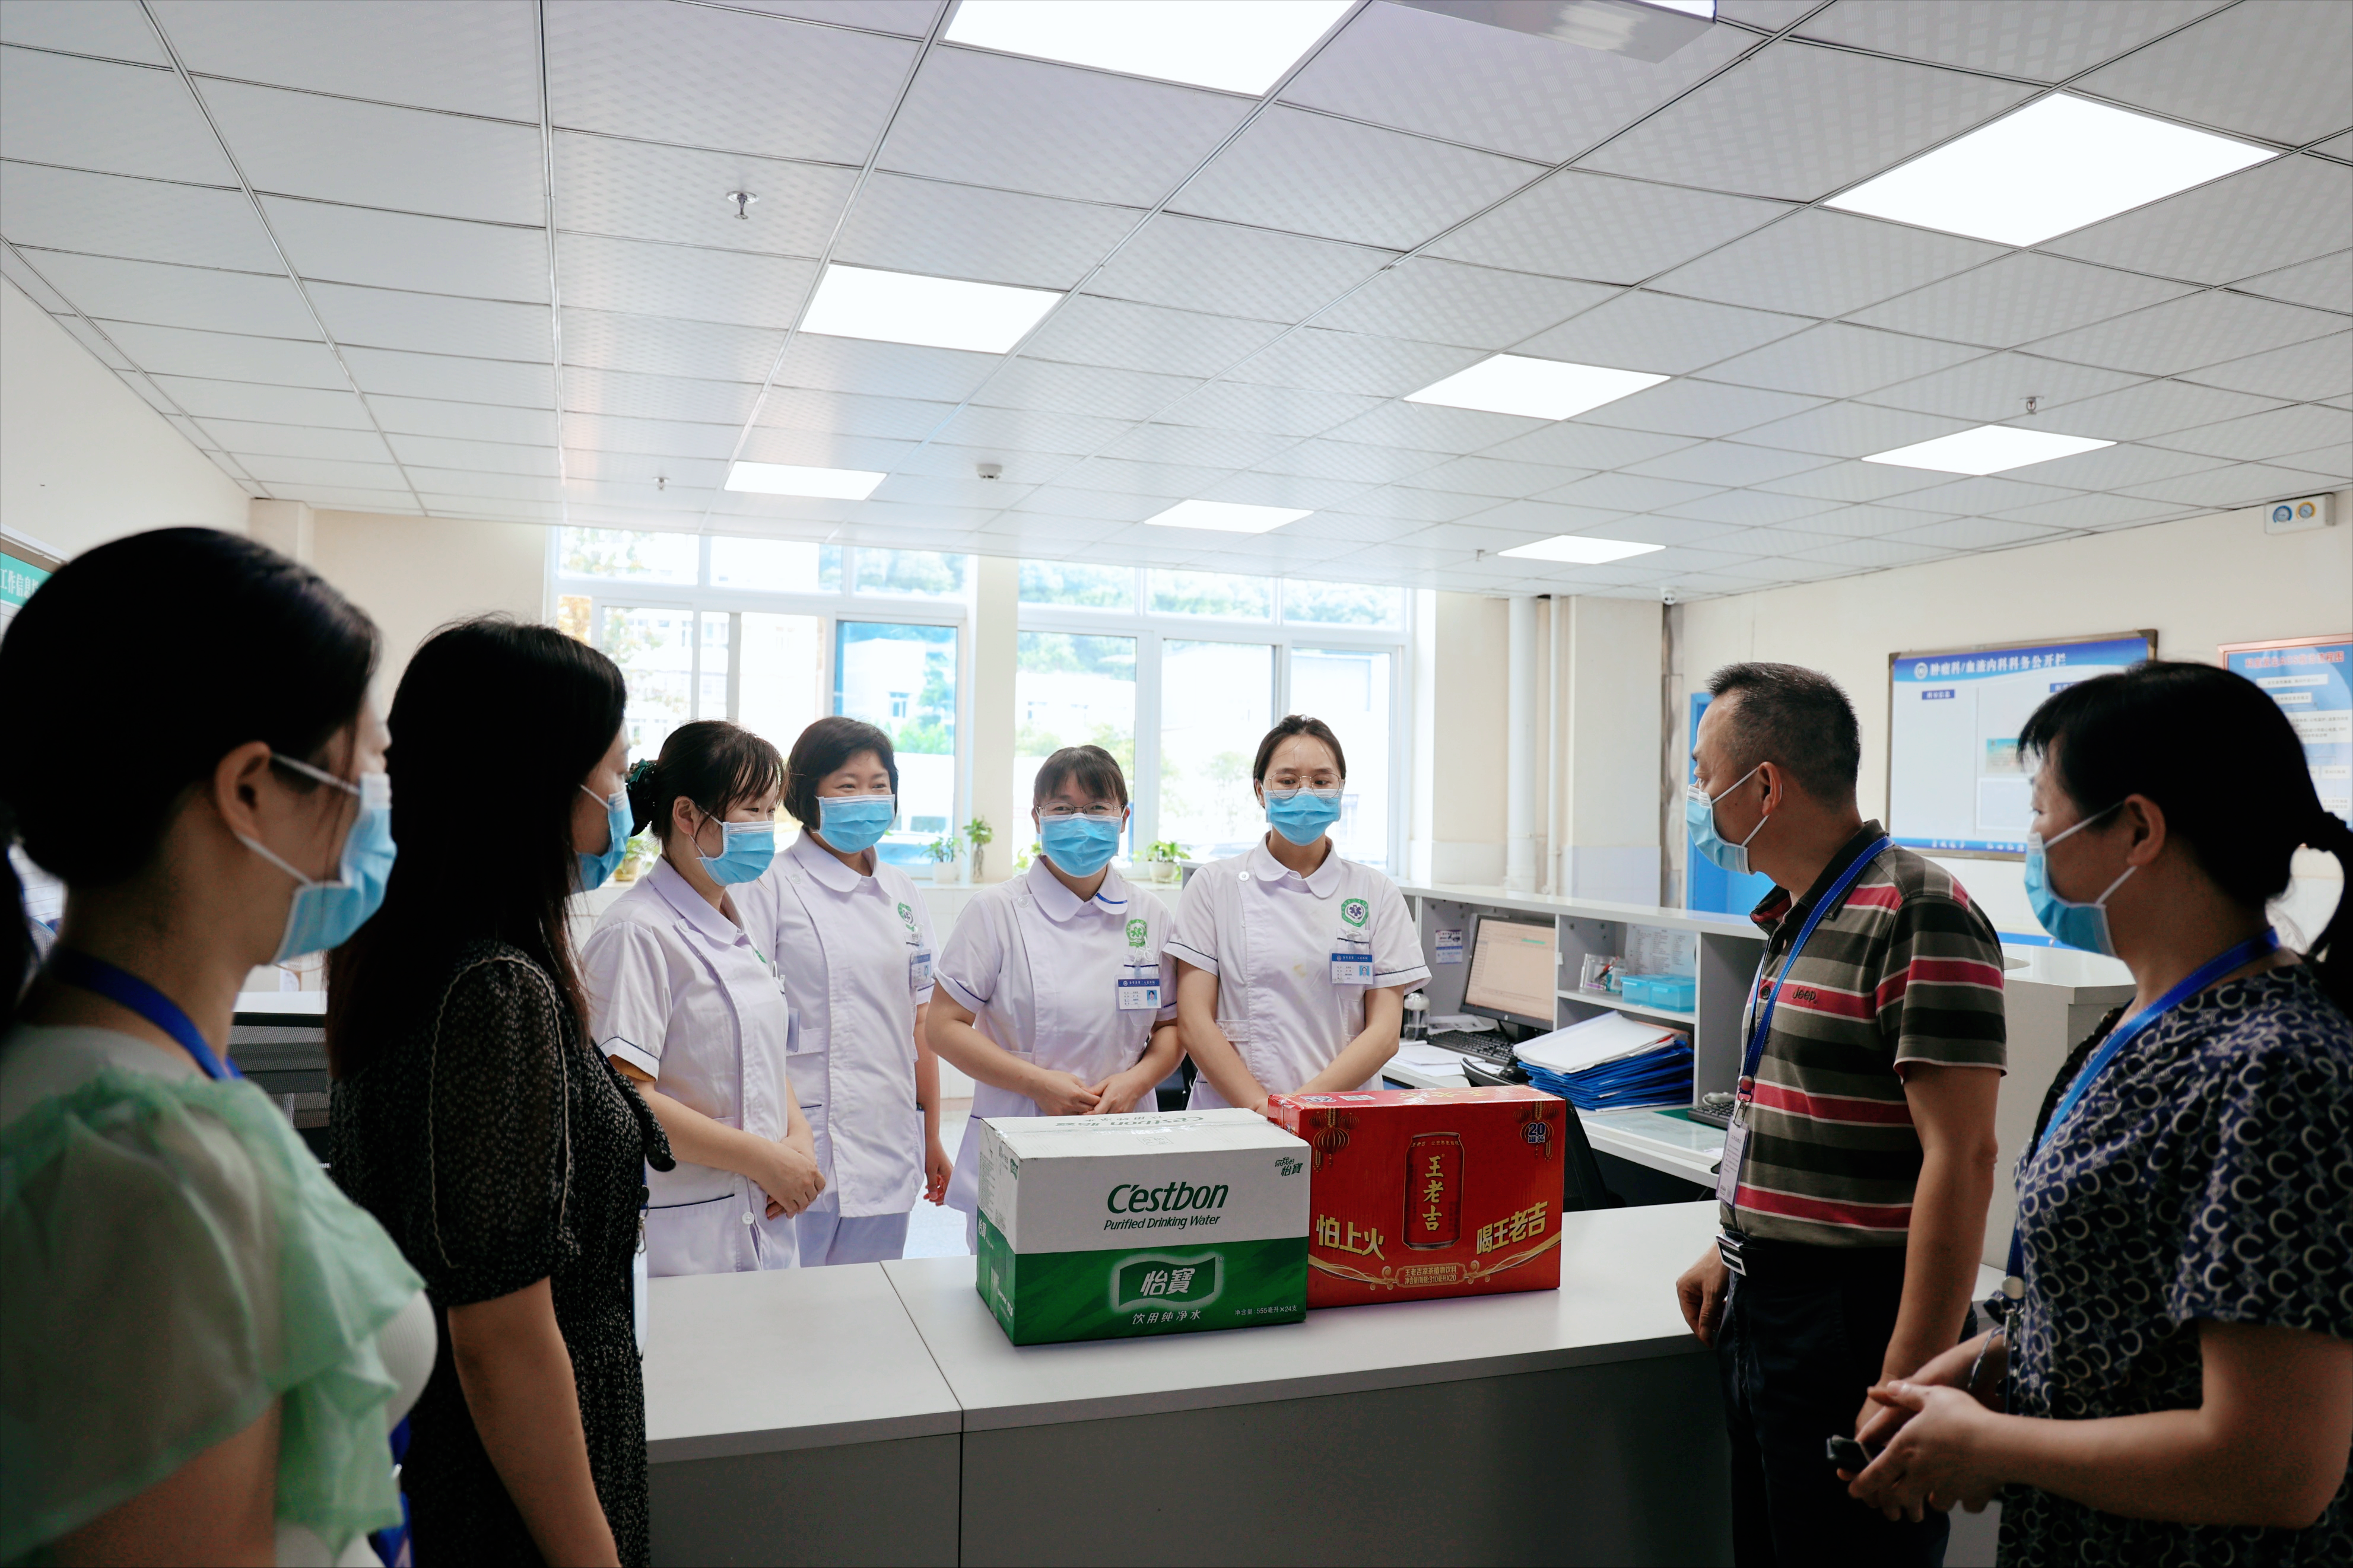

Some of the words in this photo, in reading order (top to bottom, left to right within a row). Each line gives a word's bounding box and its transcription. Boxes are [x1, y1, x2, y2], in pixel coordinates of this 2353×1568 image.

[1528, 1122, 1546, 1136] 20
[1422, 1155, 1444, 1231] 王老吉
[1103, 1218, 1146, 1230] Purified
[1147, 1217, 1187, 1230] Drinking
[1190, 1214, 1221, 1226] Water
[1316, 1214, 1385, 1261] 怕上火
[1476, 1201, 1548, 1255] 喝王老吉
[1132, 1309, 1201, 1325] 饮用纯净水
